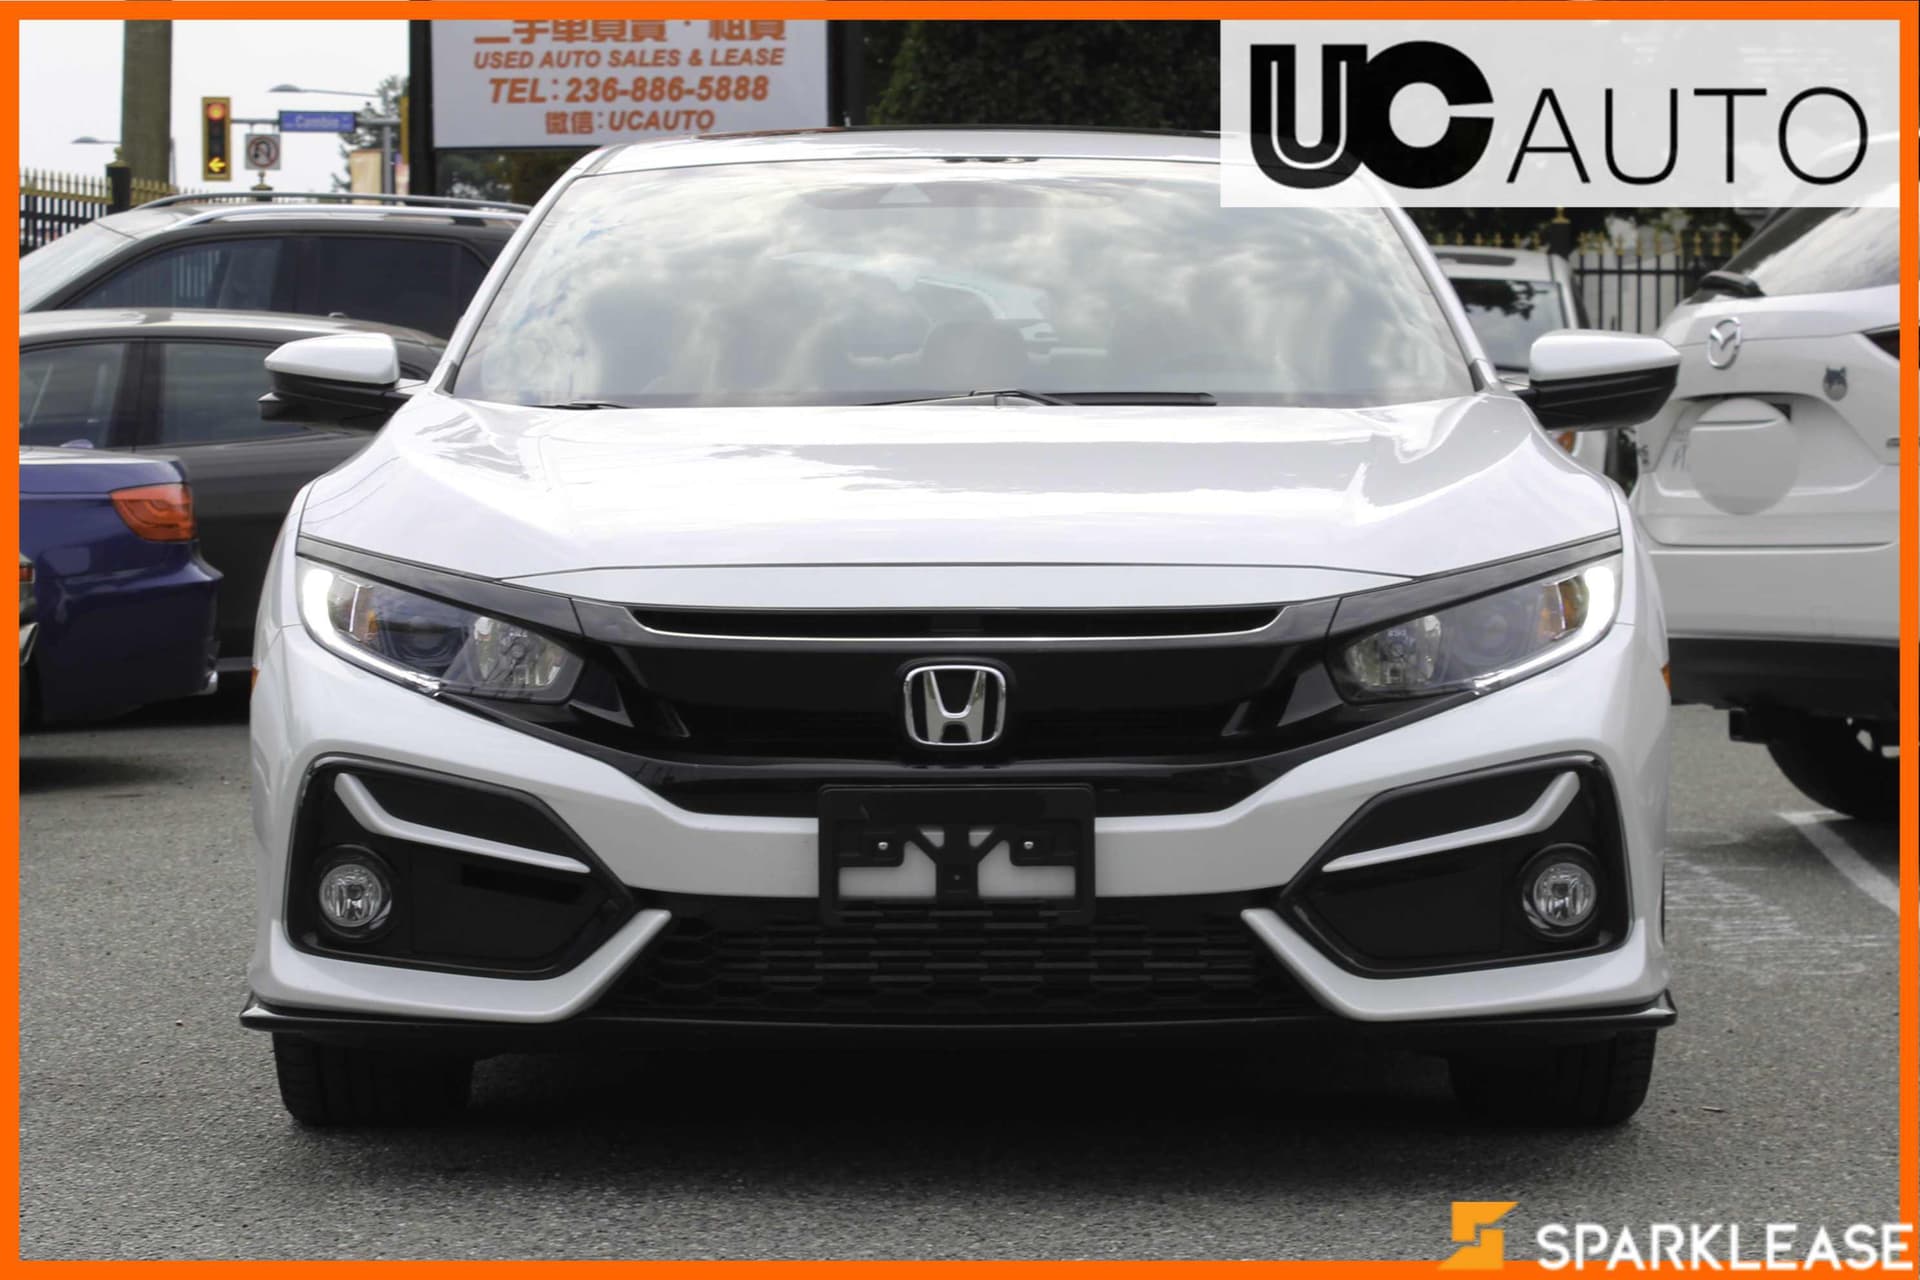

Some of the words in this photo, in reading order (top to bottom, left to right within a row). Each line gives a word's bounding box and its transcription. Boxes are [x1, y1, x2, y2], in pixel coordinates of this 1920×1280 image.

[474, 51, 534, 69] USED
[538, 50, 602, 68] AUTO
[608, 49, 681, 67] SALES
[688, 49, 703, 66] &
[709, 48, 785, 66] LEASE
[565, 75, 770, 103] 236-886-5888
[608, 110, 715, 132] UCAUTO
